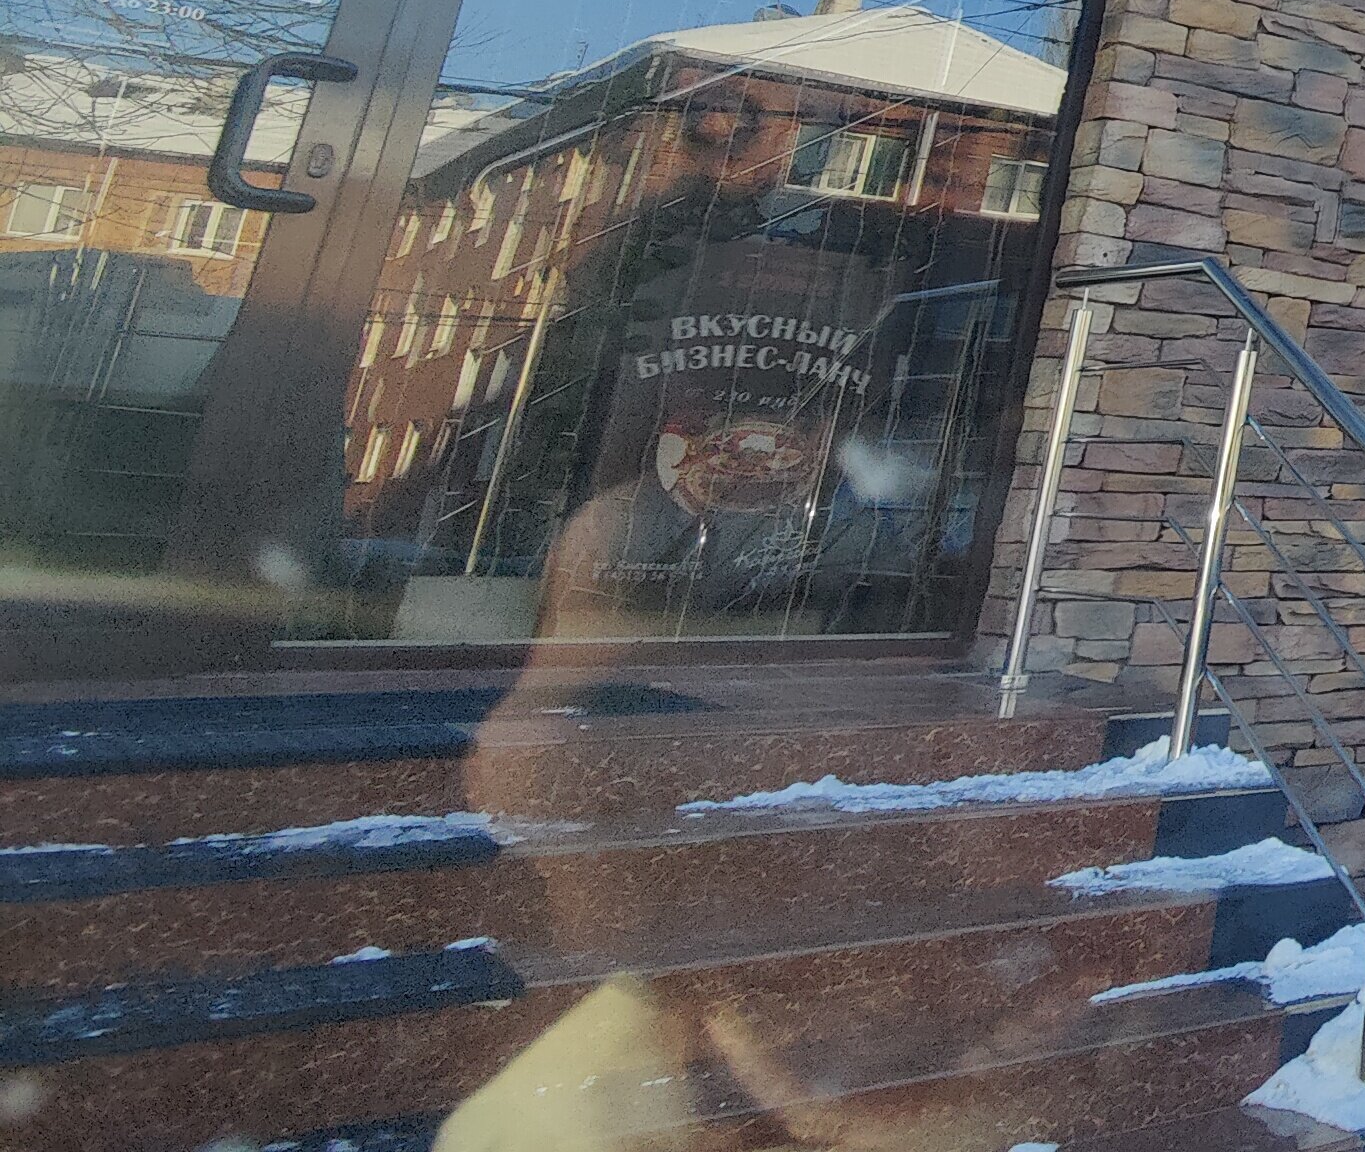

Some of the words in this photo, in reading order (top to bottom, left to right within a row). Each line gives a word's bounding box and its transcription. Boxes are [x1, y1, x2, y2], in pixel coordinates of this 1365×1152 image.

[147, 0, 206, 21] 23:00
[670, 314, 858, 355] ВКУСНЫЙ
[636, 345, 872, 395] БИЗНЕС-ЛАНЧ
